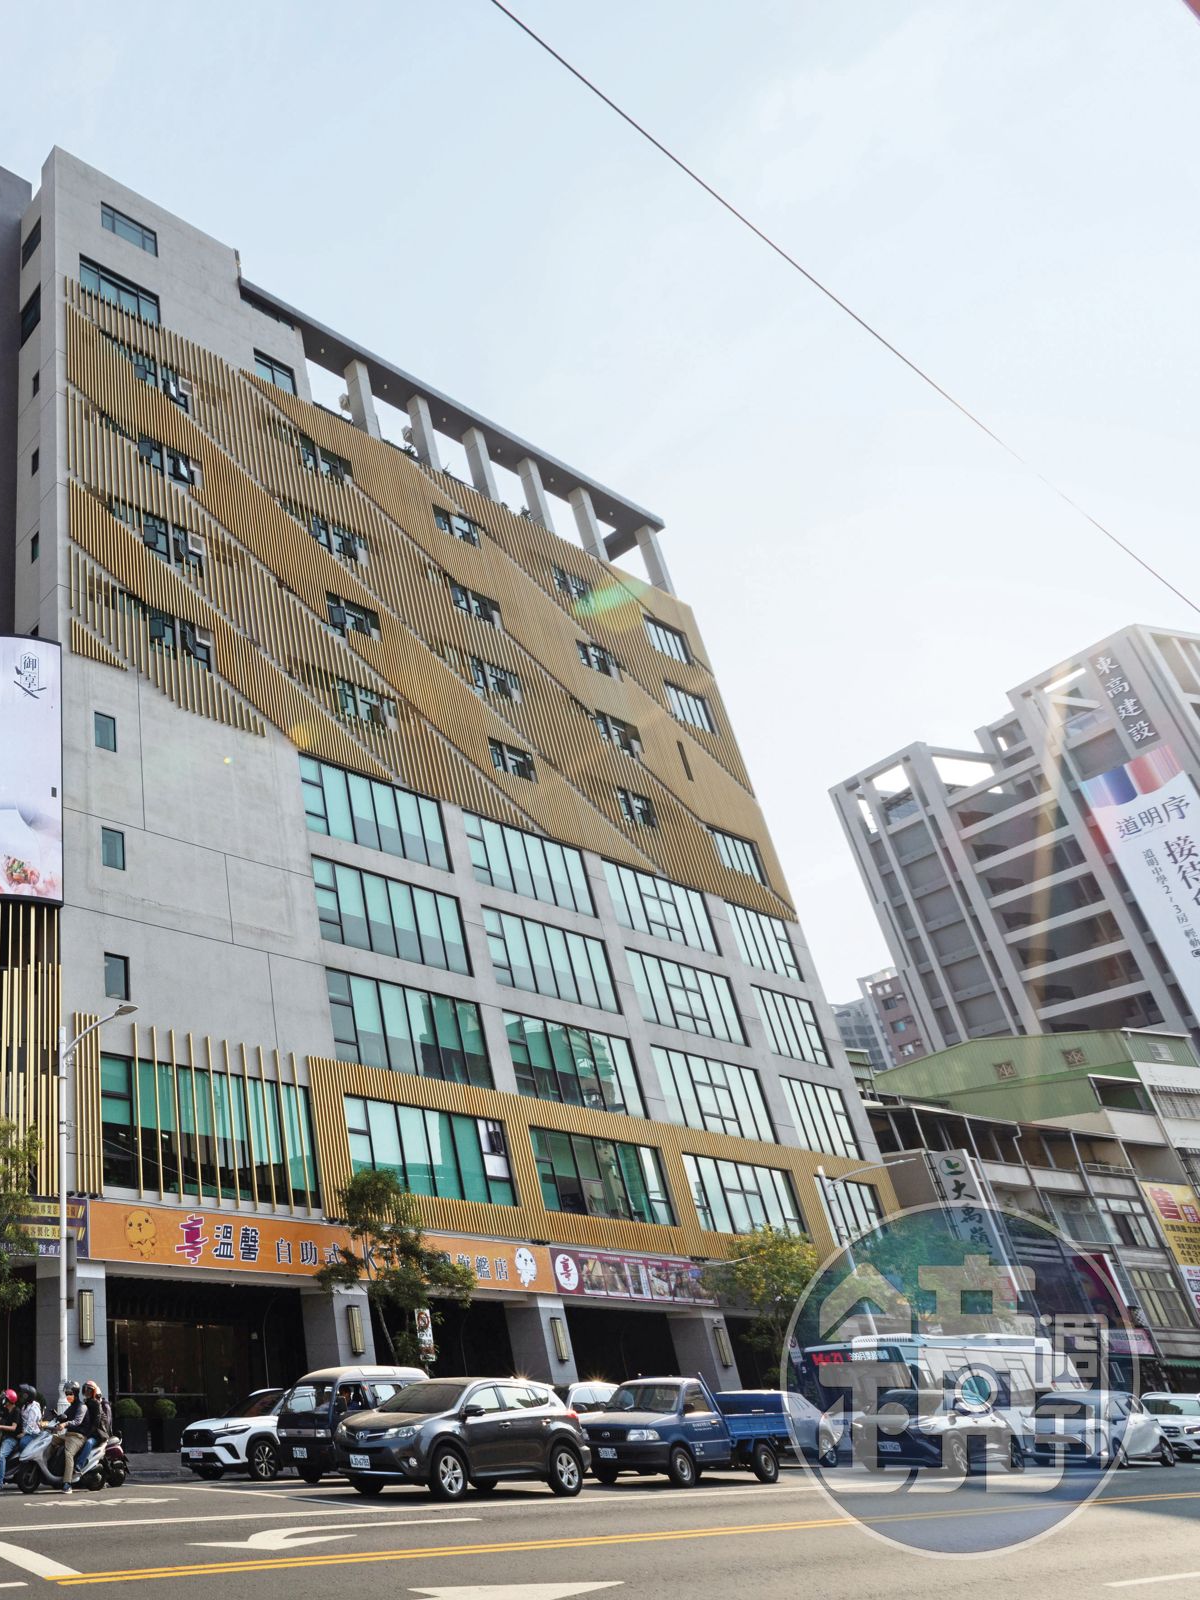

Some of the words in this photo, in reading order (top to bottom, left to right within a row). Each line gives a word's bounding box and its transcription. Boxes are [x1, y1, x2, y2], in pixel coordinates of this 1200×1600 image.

[1094, 655, 1156, 743] 東高建設
[1115, 794, 1190, 838] 道明序
[276, 1238, 343, 1266] 自助式
